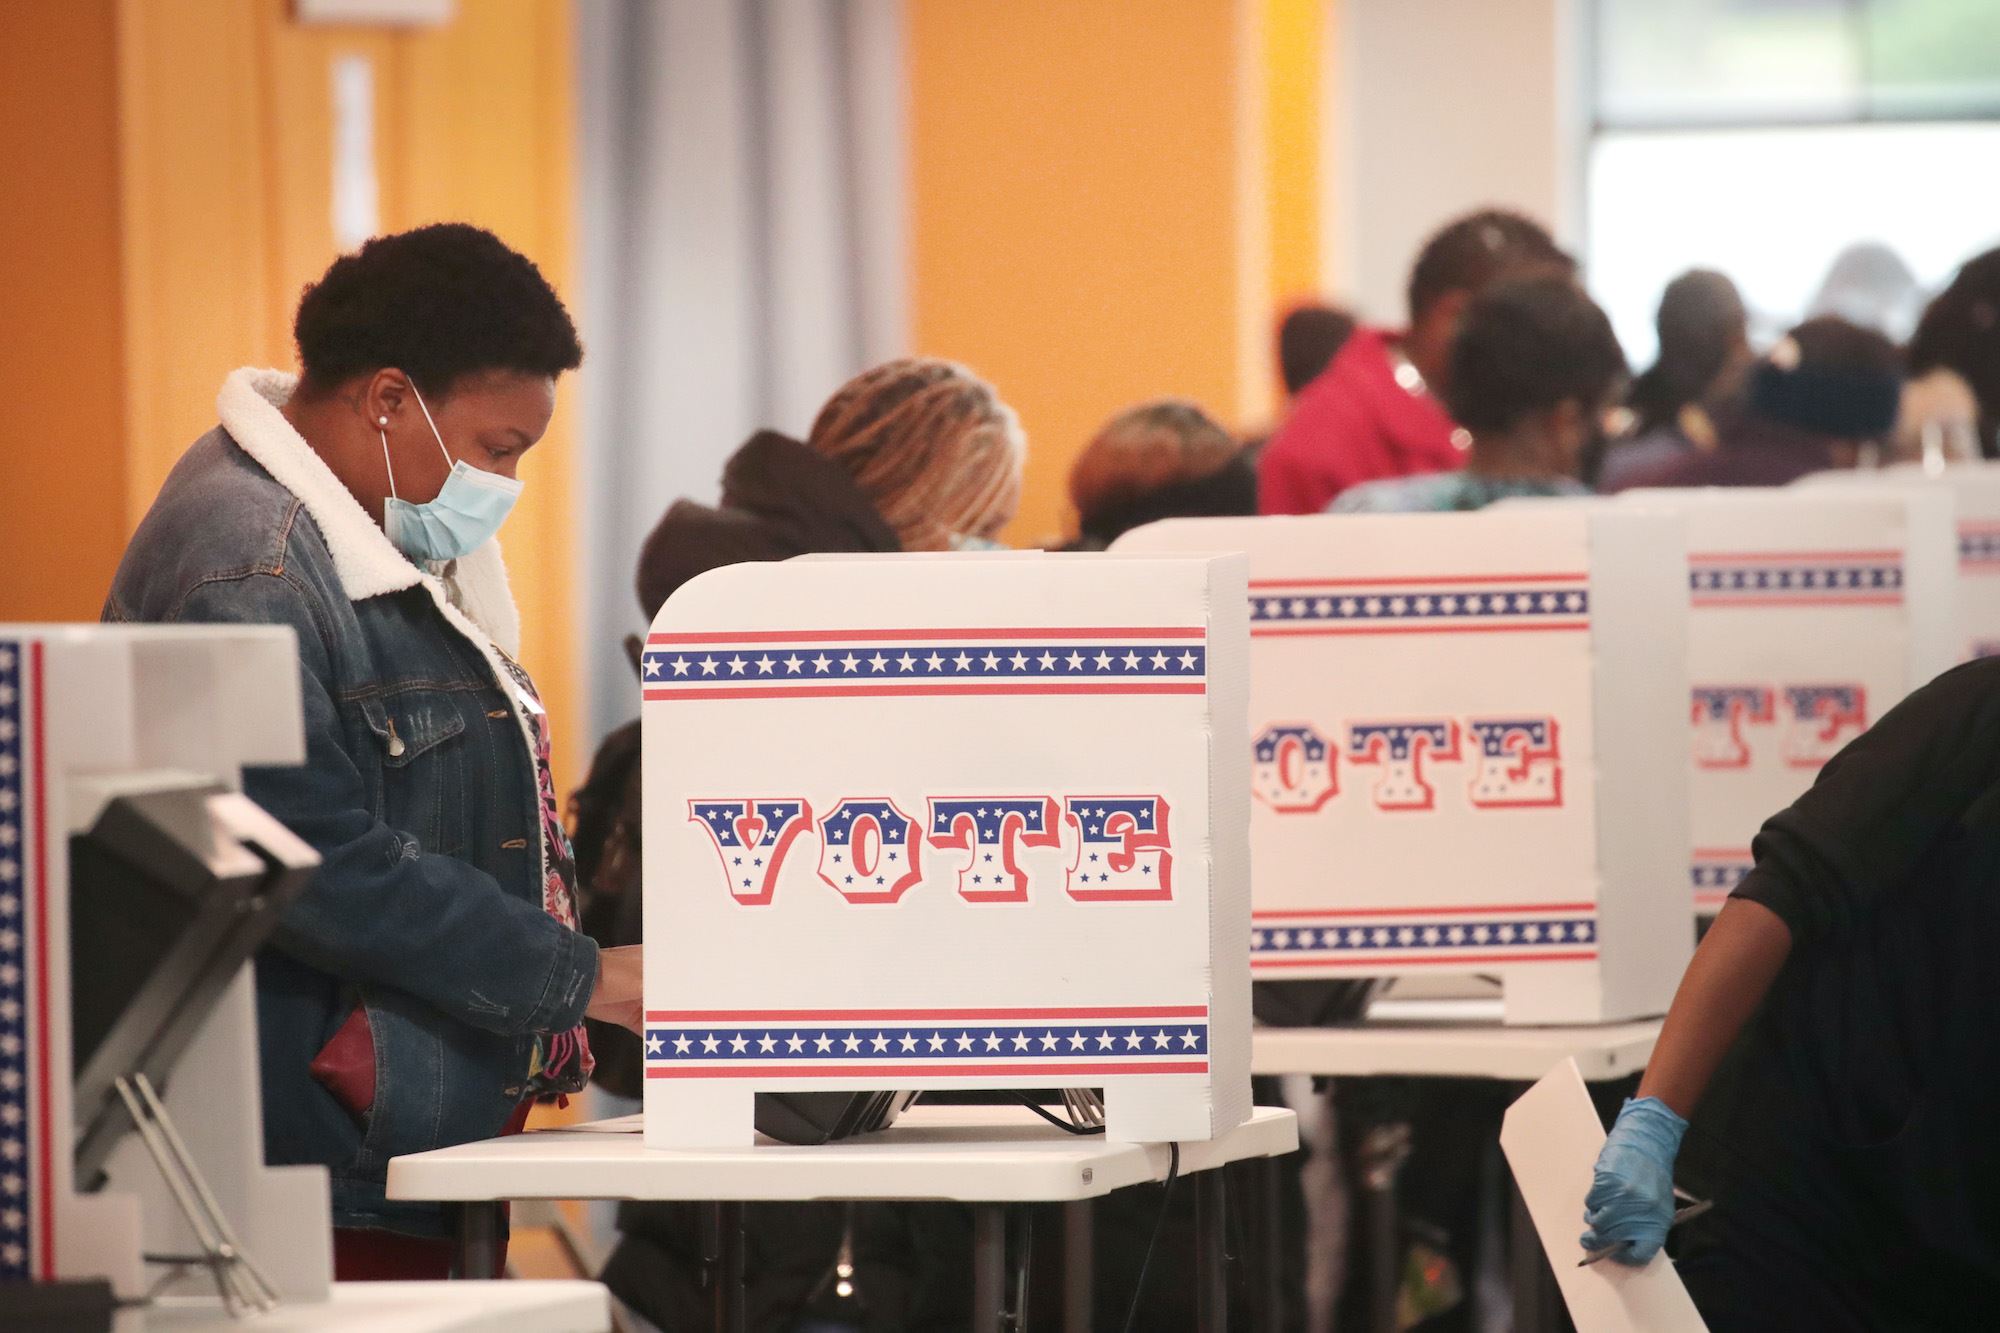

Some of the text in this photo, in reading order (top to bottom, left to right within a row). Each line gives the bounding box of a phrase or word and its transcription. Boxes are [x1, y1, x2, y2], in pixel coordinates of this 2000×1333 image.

[1252, 719, 1563, 814] OTE
[1690, 685, 1866, 768] TE
[687, 795, 1174, 905] VOTE
